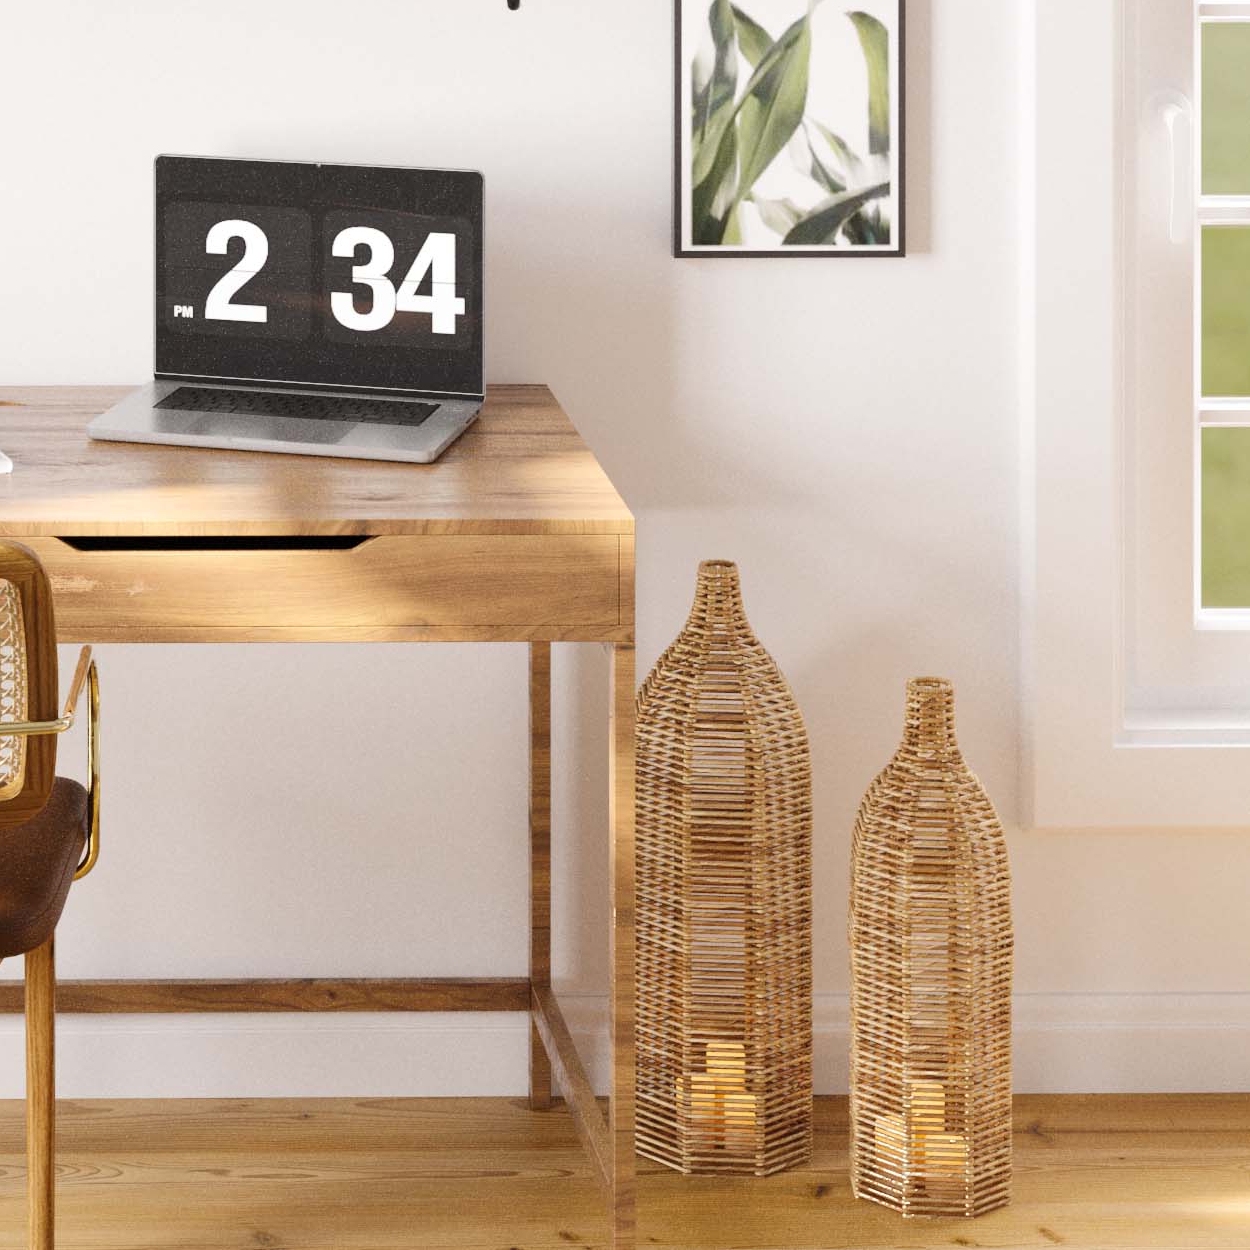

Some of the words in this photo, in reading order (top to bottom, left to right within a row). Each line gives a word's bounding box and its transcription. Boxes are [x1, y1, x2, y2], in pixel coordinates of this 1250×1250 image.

[173, 305, 194, 319] PM
[205, 219, 269, 323] 2
[331, 226, 466, 335] 34
